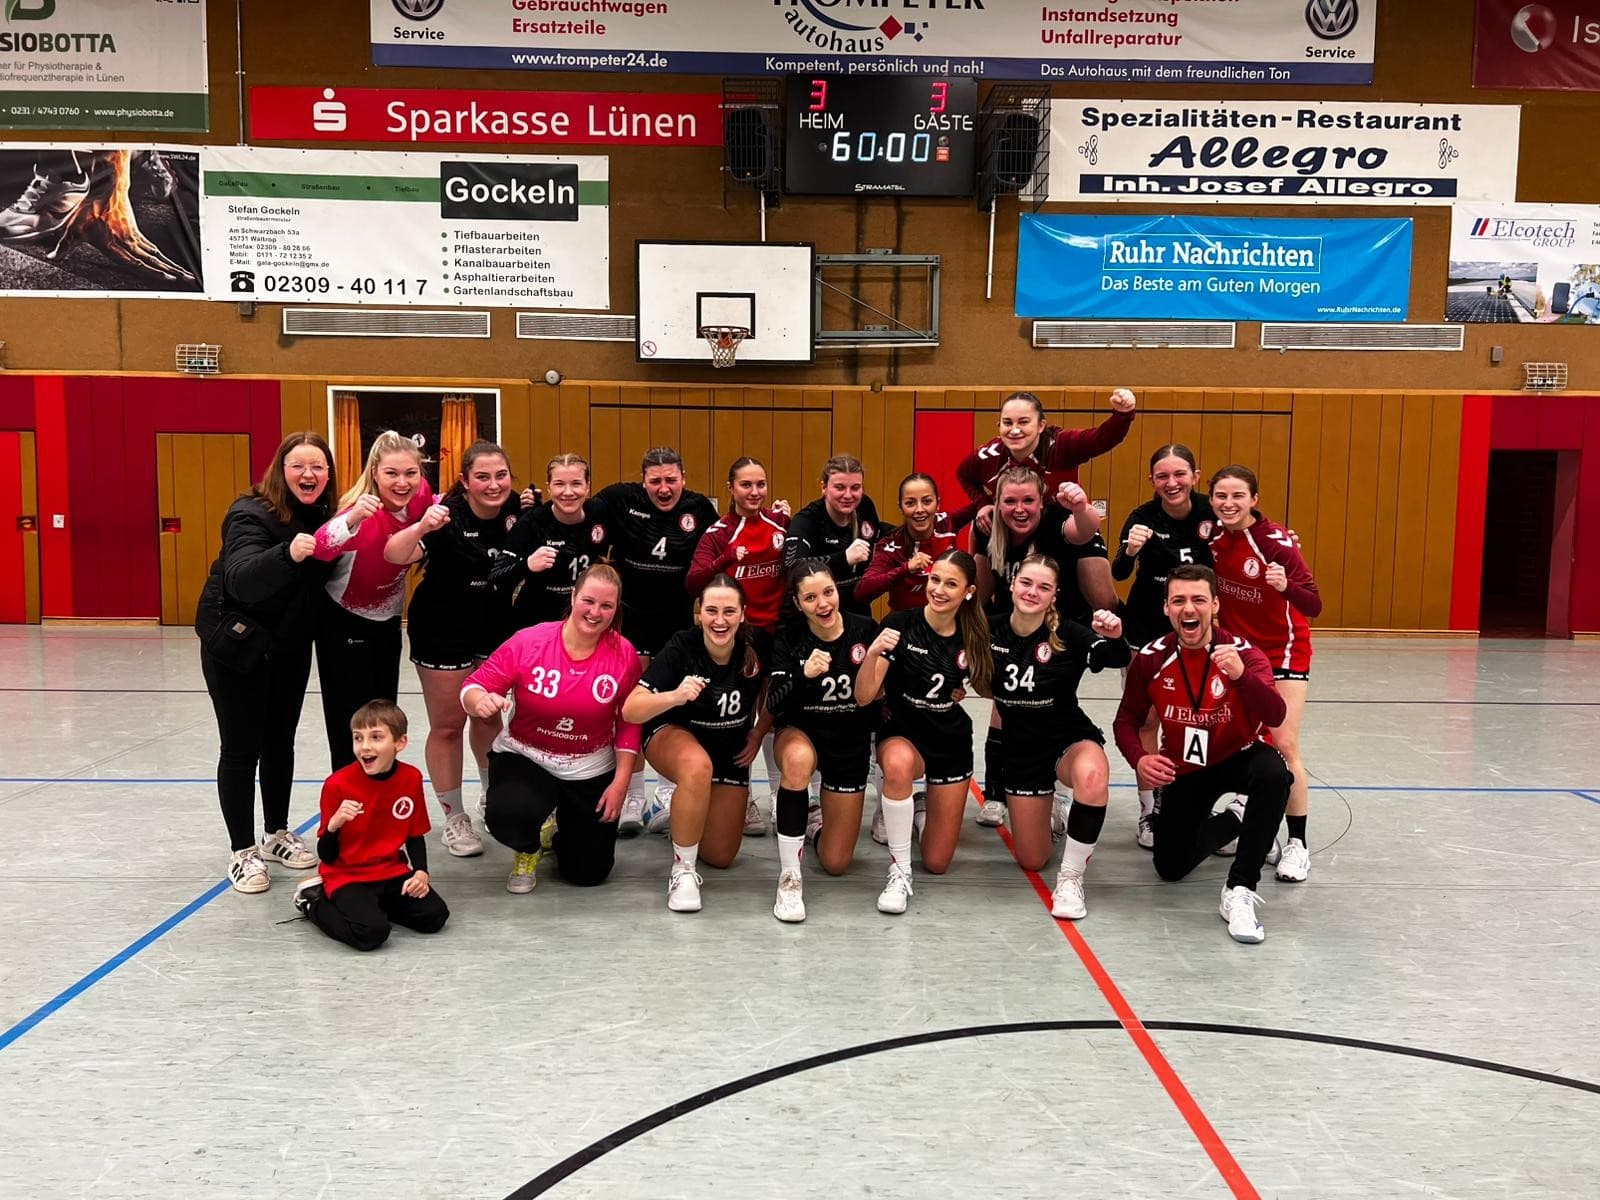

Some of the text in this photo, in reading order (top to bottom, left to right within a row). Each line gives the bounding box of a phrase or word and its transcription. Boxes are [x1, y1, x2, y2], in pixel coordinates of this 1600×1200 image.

[512, 0, 668, 17] Gebrauchtwagen
[1041, 7, 1179, 27] Instandsetzung
[393, 26, 445, 40] Service
[512, 18, 607, 35] Ersatzteile
[784, 8, 885, 53] autohaus
[1041, 29, 1183, 48] Unfallreparatur
[512, 53, 668, 68] www.trompeter24.de
[1305, 46, 1356, 58] Service
[28, 61, 93, 73] Physiotherapie
[95, 62, 103, 70] &
[765, 57, 984, 75] Kompetent, persönlich und nah!
[1041, 64, 1291, 80] Das Autohaus mit dem freundlichen Ton
[86, 74, 94, 82] in
[96, 73, 125, 82] Lünen
[809, 80, 949, 112] 3 3
[11, 106, 31, 115] 0231
[37, 107, 58, 115] 4743
[94, 108, 175, 118] www.physiobotta.de
[386, 101, 570, 141] Sparkasse
[588, 105, 697, 138] Lünen
[799, 111, 974, 131] HEIM GÄSTE
[831, 131, 931, 163] 60:00
[1148, 135, 1388, 175] Allegro
[445, 176, 576, 205] Gockeln
[1103, 176, 1434, 197] Inh. Josef Allegro
[228, 205, 300, 216] Stefan Gockeln
[241, 228, 286, 236] Schwarzbach
[454, 230, 540, 241] Tiefbauarbeiten
[1492, 220, 1576, 239] Elcotech
[454, 244, 542, 255] Pflasterarbeiten
[1532, 238, 1575, 248] GROUP
[1109, 240, 1314, 267] Ruhr Nachrichten
[454, 258, 551, 269] Kanalbauarbeiten
[264, 275, 330, 293] 02309
[350, 277, 376, 295] 40
[416, 279, 428, 296] 7
[453, 272, 555, 284] Asphaltierarbeiten
[1102, 275, 1321, 297] Das Beste am Guten Morgen
[453, 286, 574, 297] Gartenlandschaftsbau
[1317, 306, 1402, 314] www.RuhrNachrichten.de
[651, 536, 667, 560] 4
[1179, 548, 1194, 564] 5
[528, 666, 561, 698] 33
[926, 673, 945, 699] 2
[1003, 663, 1036, 693] 34
[821, 674, 853, 702] 23
[717, 690, 741, 717] 18
[536, 726, 588, 741] PHYSIOBOTTA
[1185, 733, 1206, 765] A
